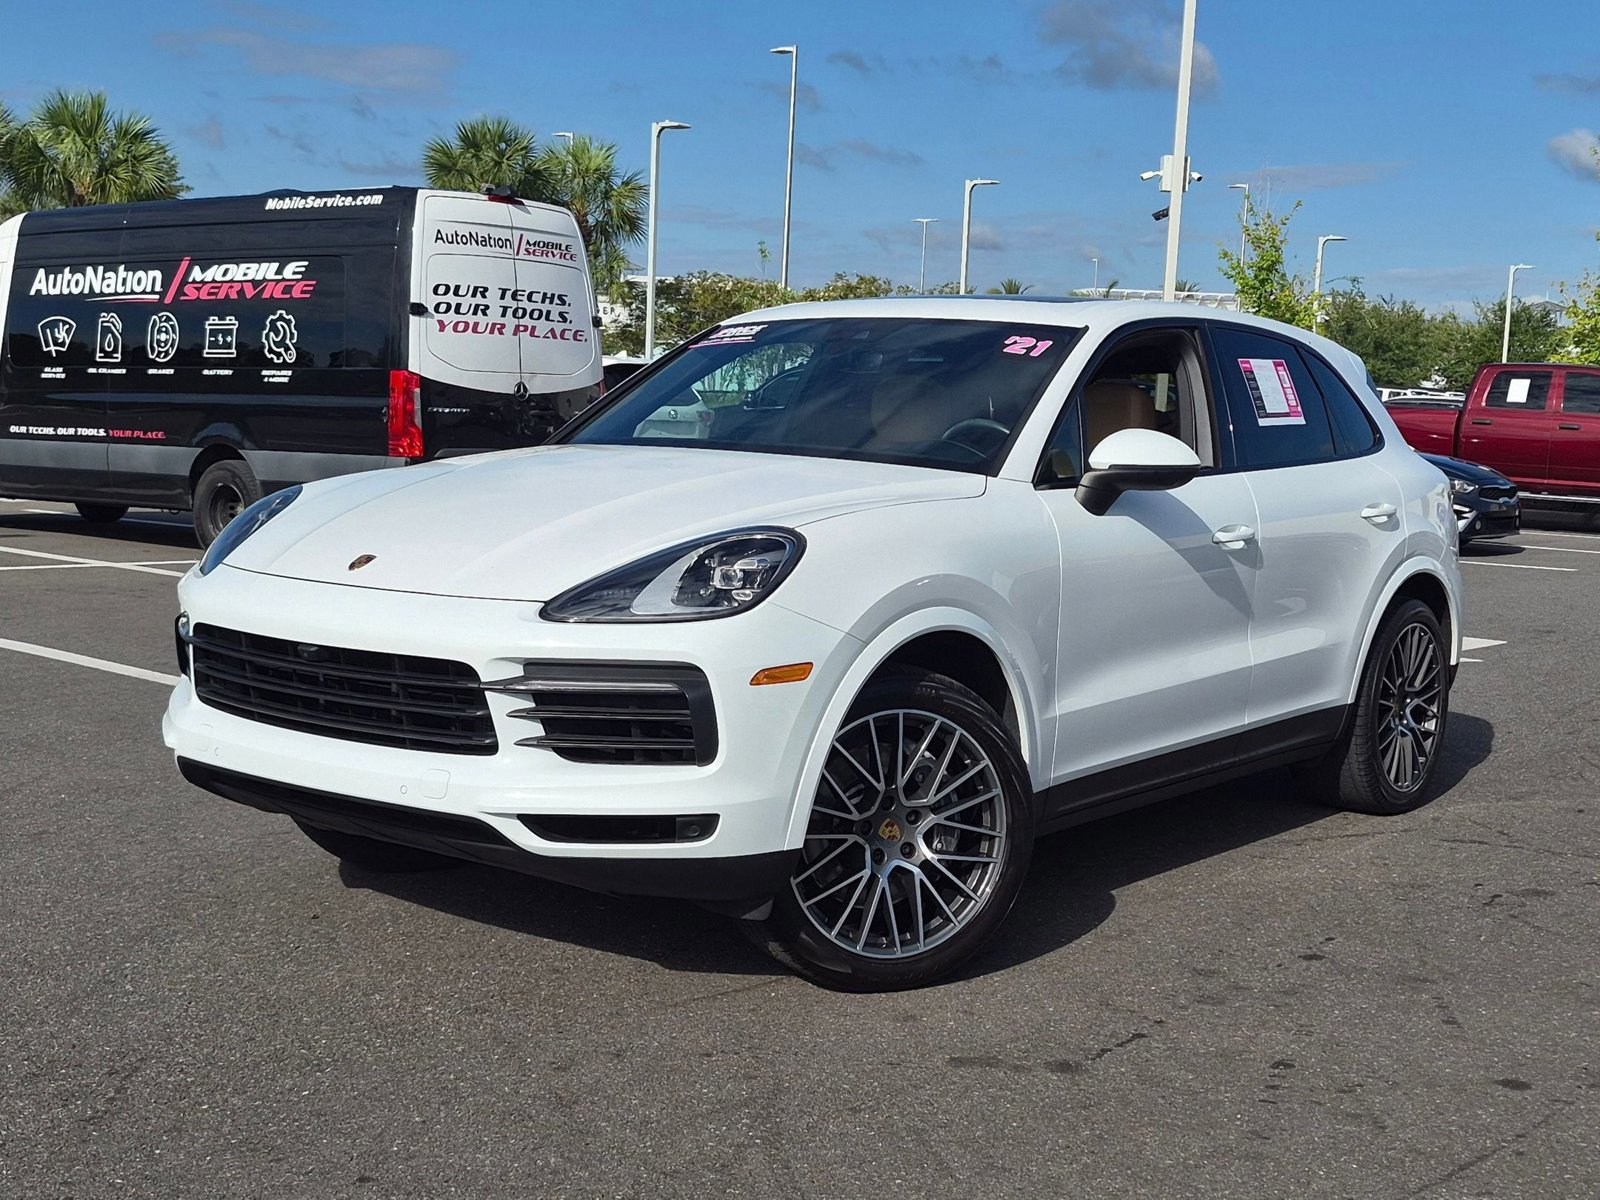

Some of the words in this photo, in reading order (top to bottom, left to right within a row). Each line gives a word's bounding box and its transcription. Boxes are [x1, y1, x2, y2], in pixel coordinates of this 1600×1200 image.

[265, 194, 384, 210] MobileService.com
[434, 229, 512, 250] AutoNation
[525, 238, 573, 253] MOBILE
[523, 247, 577, 262] SERVICE
[29, 264, 162, 295] AutoNation
[188, 261, 309, 283] MOBILE
[180, 281, 317, 300] SERVICE
[432, 283, 489, 299] OUR
[498, 287, 572, 307] TECHS.
[433, 301, 489, 317] OUR
[498, 305, 573, 324] TOOLS.
[436, 319, 507, 336] YOUR
[512, 324, 588, 343] PLACE.
[9, 425, 27, 434] OUR
[57, 427, 75, 436] OUR
[76, 427, 106, 436] TOOLS.
[108, 429, 133, 438] YOUR
